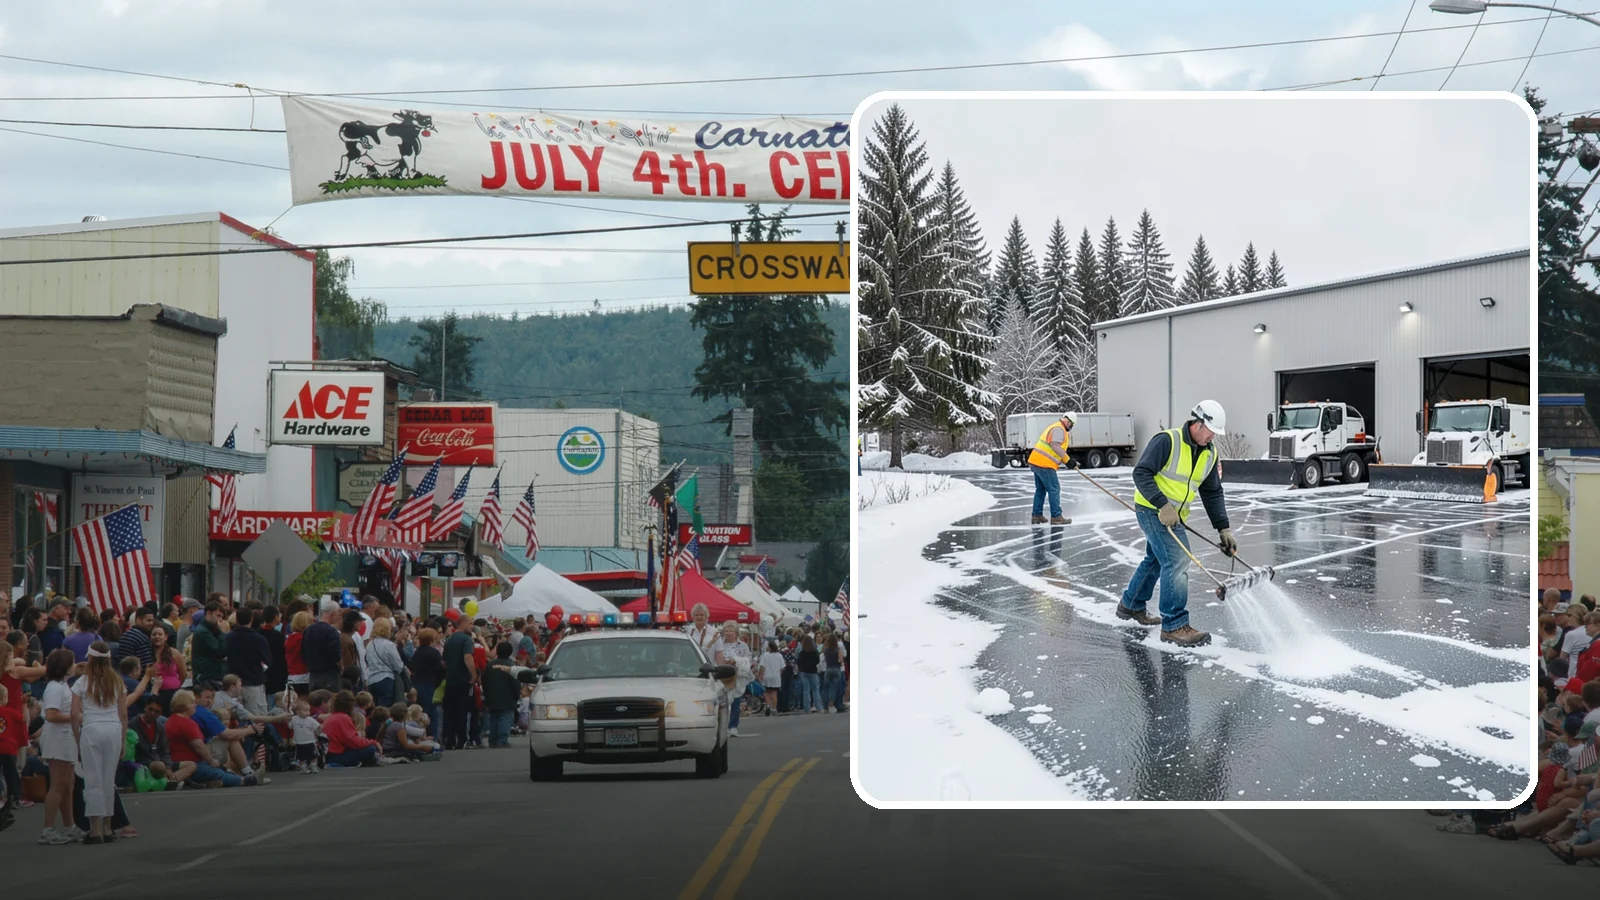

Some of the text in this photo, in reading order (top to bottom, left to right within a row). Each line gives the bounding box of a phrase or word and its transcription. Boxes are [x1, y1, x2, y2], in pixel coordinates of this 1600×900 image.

[481, 141, 604, 192] JULY
[632, 150, 746, 197] 4th.
[697, 254, 850, 280] CROSSWA
[282, 380, 373, 420] ACE
[406, 409, 485, 422] CEDAR LOG
[283, 421, 370, 436] Hardware
[83, 485, 155, 495] St. Vincent de Paul
[688, 526, 741, 535] CRNATION
[699, 535, 730, 543] GLASS
